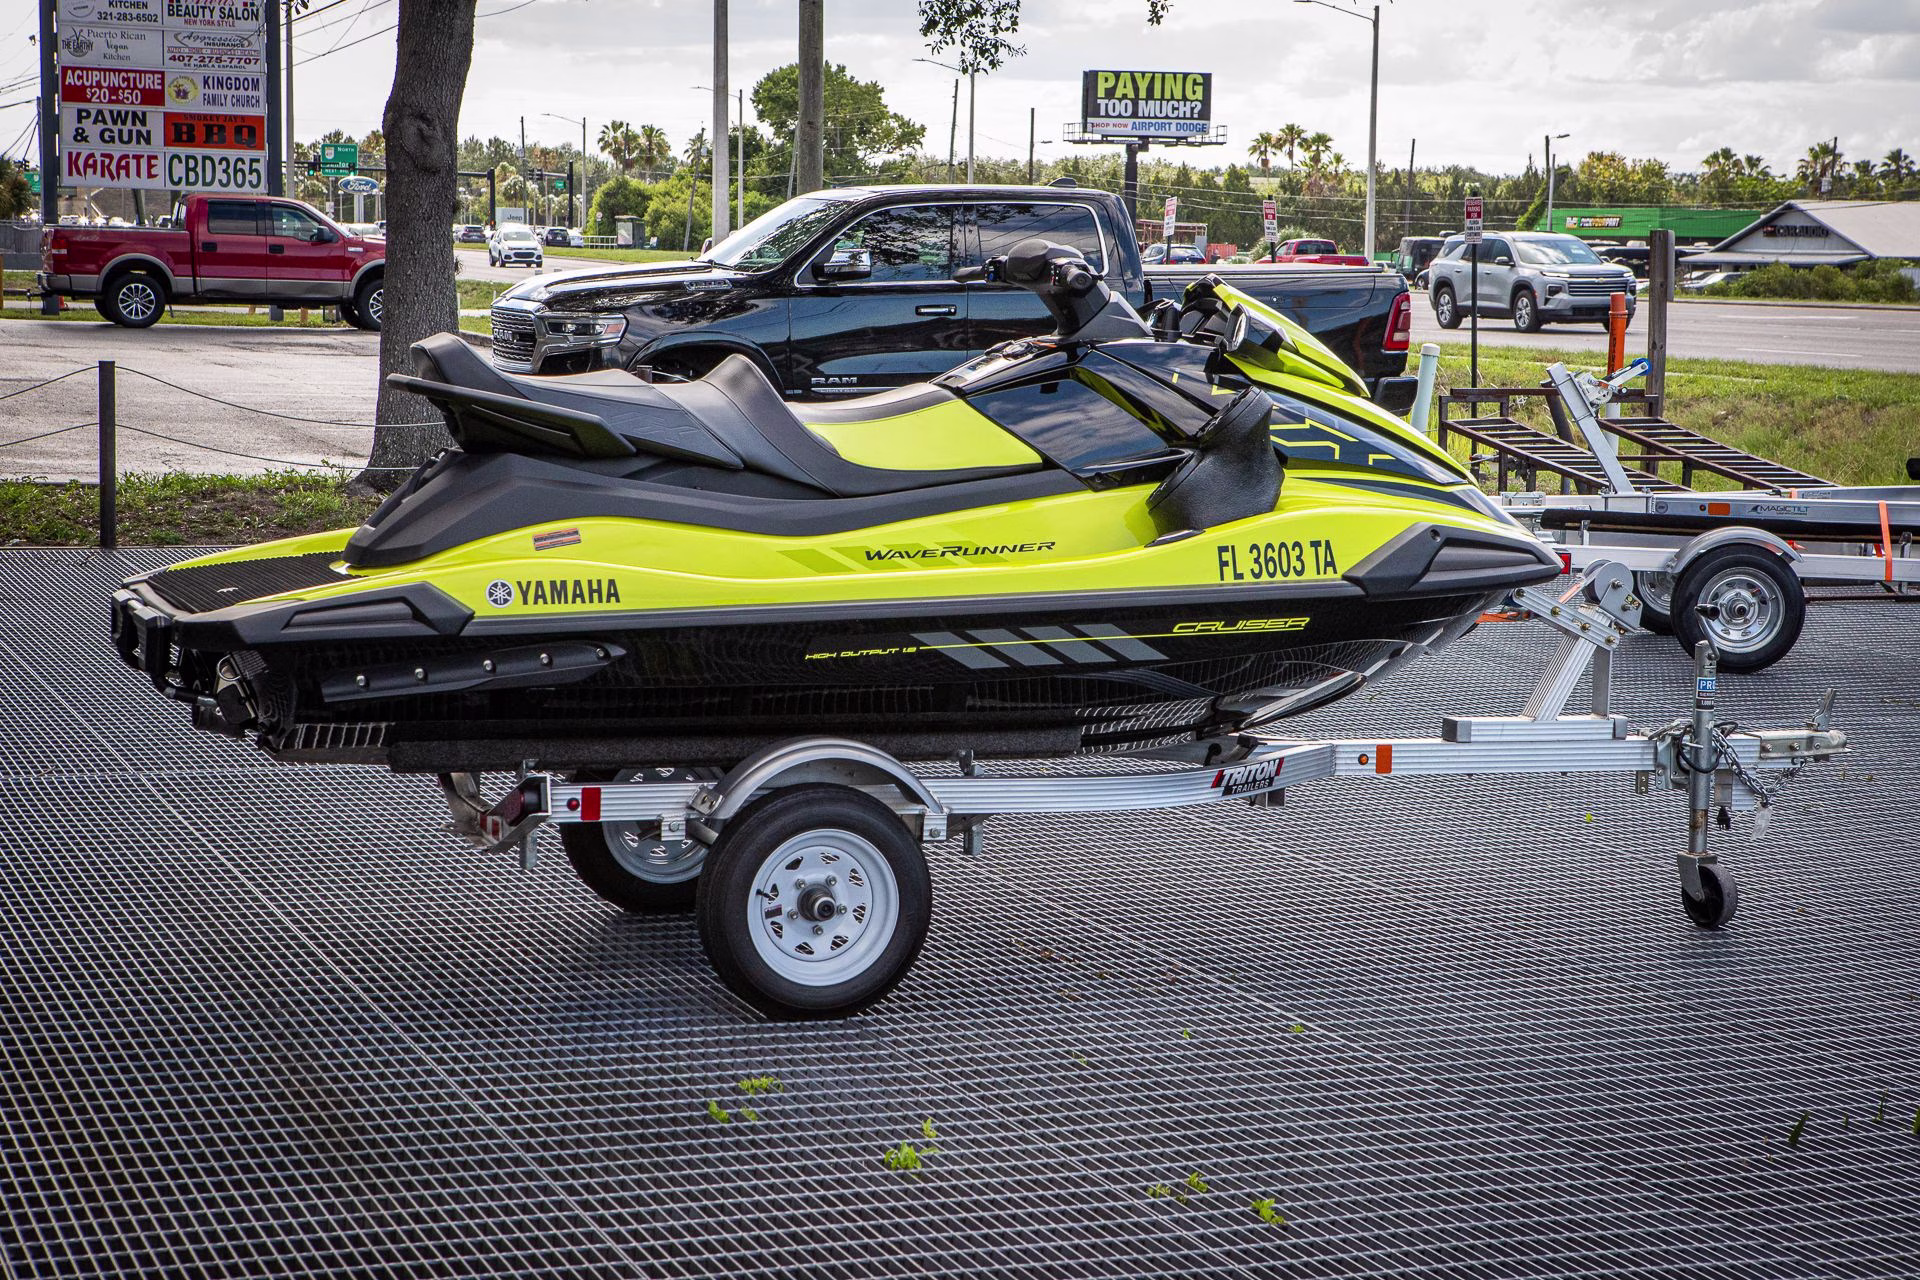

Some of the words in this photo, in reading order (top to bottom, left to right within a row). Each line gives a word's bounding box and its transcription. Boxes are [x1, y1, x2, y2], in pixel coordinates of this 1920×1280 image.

[108, 0, 148, 9] KITCHEN
[97, 11, 158, 22] 321-283-6502
[167, 4, 215, 19] BEAUTY
[219, 7, 259, 21] SALON
[200, 19, 216, 27] YORK
[87, 29, 118, 39] Puerto
[120, 30, 146, 40] Rican
[62, 40, 72, 50] THE
[105, 39, 128, 52] Vegan
[103, 53, 131, 61] Kitchen
[169, 54, 260, 65] 407-275-7707
[65, 70, 162, 90] ACUPUNCTURE
[202, 76, 260, 92] KINGDOM
[1097, 72, 1203, 101] PAYING
[202, 93, 228, 107] FAMILY
[231, 95, 260, 108] CHURCH
[1097, 99, 1133, 117] TOO
[1138, 100, 1202, 118] MUCH?
[76, 108, 147, 127] PAWN
[183, 114, 219, 122] SMOKEY
[1130, 121, 1173, 131] AIRPORT
[1176, 122, 1208, 133] DODGE
[72, 128, 89, 143] &
[99, 127, 152, 145] GUN
[67, 151, 159, 182] KARATE
[168, 153, 262, 189] CBD365
[347, 180, 372, 191] Ford
[506, 213, 522, 221] Jeep
[1217, 545, 1245, 581] FL
[1249, 541, 1306, 579] 3603
[1309, 539, 1338, 575] TA
[516, 578, 621, 605] YAMAHA
[1172, 617, 1311, 633] CRUISER
[804, 652, 838, 660] HIGH
[840, 647, 900, 657] OUTPUT
[1221, 758, 1281, 786] TRITON
[1231, 779, 1270, 794] TRAILERS
